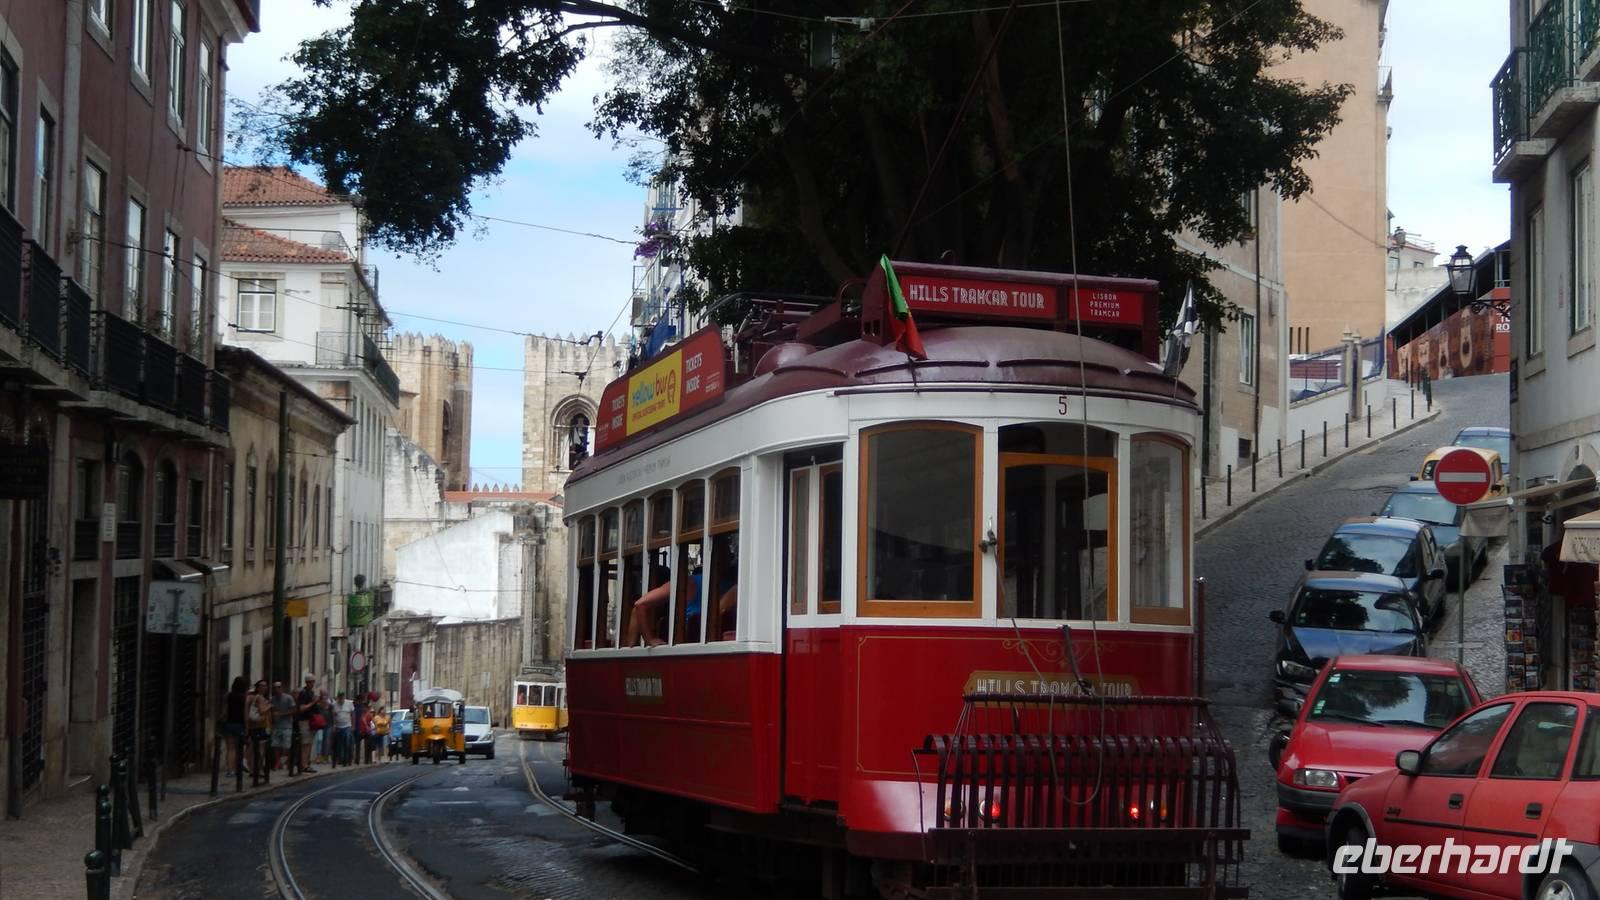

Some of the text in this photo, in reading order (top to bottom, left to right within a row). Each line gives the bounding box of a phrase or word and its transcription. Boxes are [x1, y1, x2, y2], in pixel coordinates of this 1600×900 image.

[909, 284, 1045, 309] HILLS TRAMCAR TOUR
[1089, 301, 1120, 309] PREMIUM
[1090, 309, 1120, 317] TRAMCAR
[1058, 395, 1068, 416] 5
[976, 679, 1025, 695] HILLS
